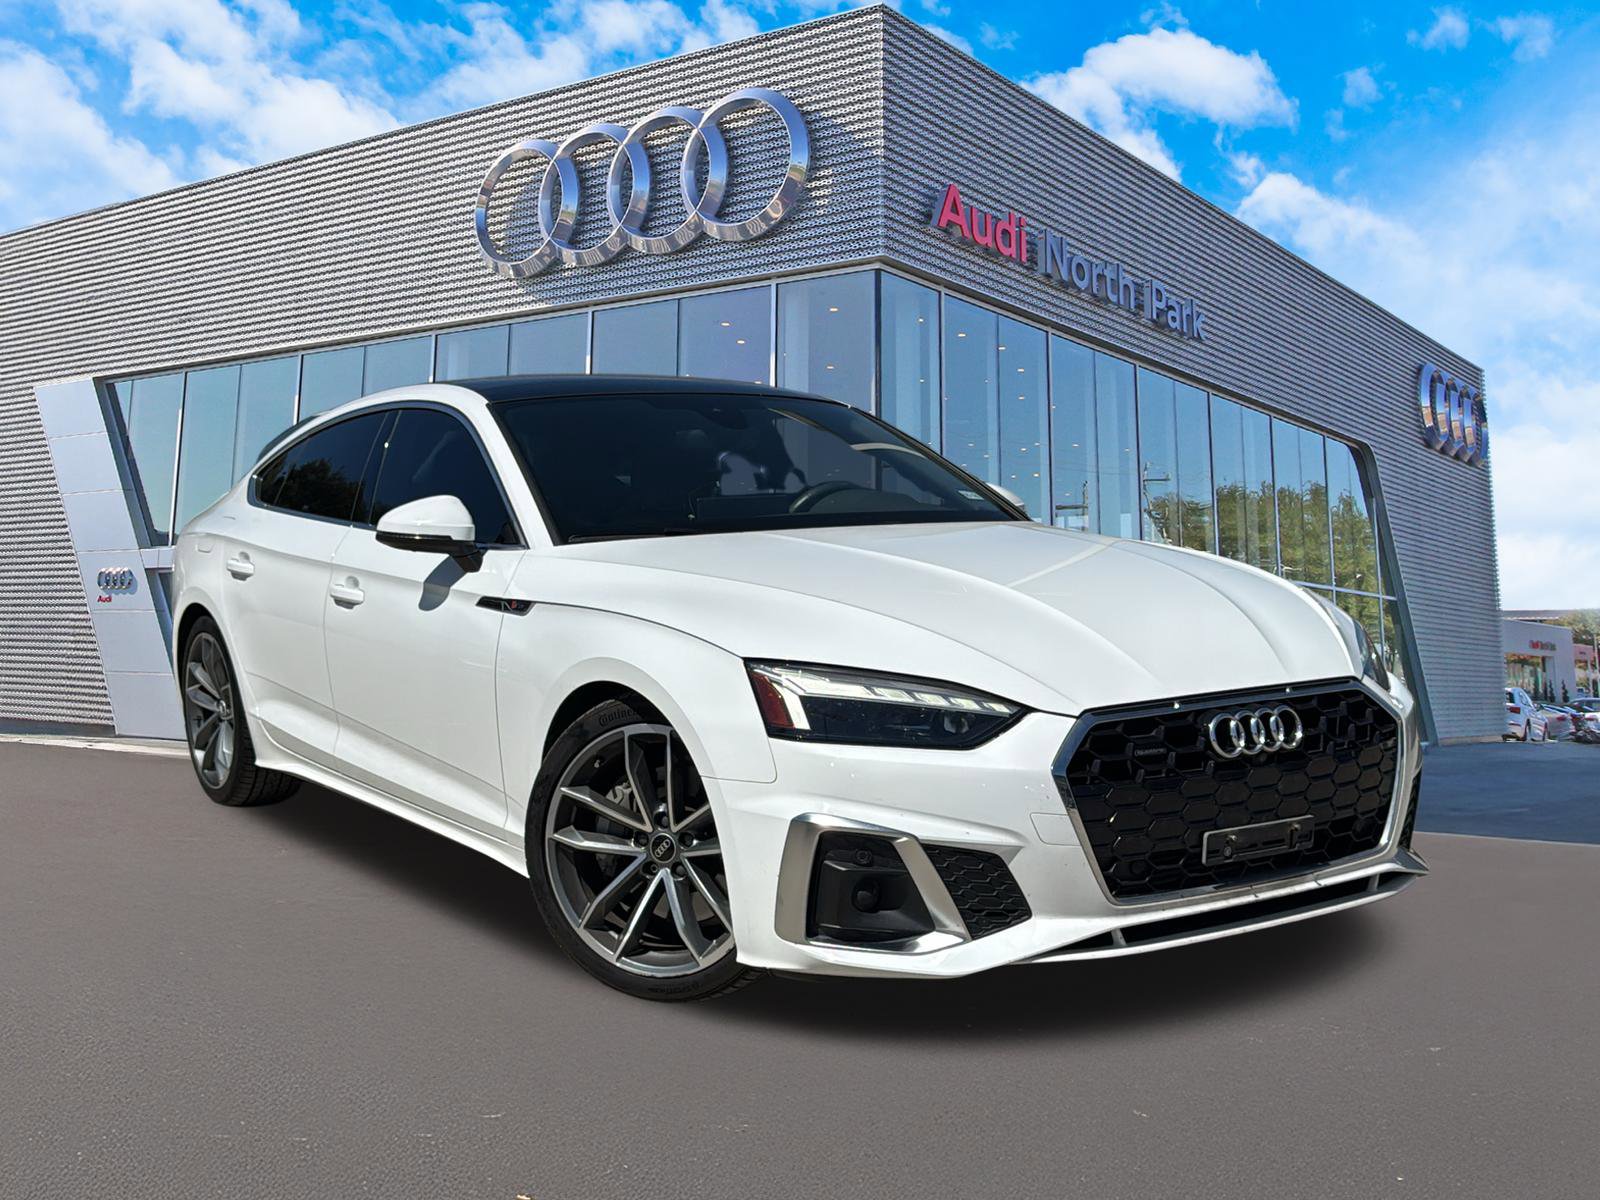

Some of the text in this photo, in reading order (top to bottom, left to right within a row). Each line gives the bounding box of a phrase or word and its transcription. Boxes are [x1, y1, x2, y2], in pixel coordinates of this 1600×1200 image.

[934, 183, 1208, 341] Audi North Park
